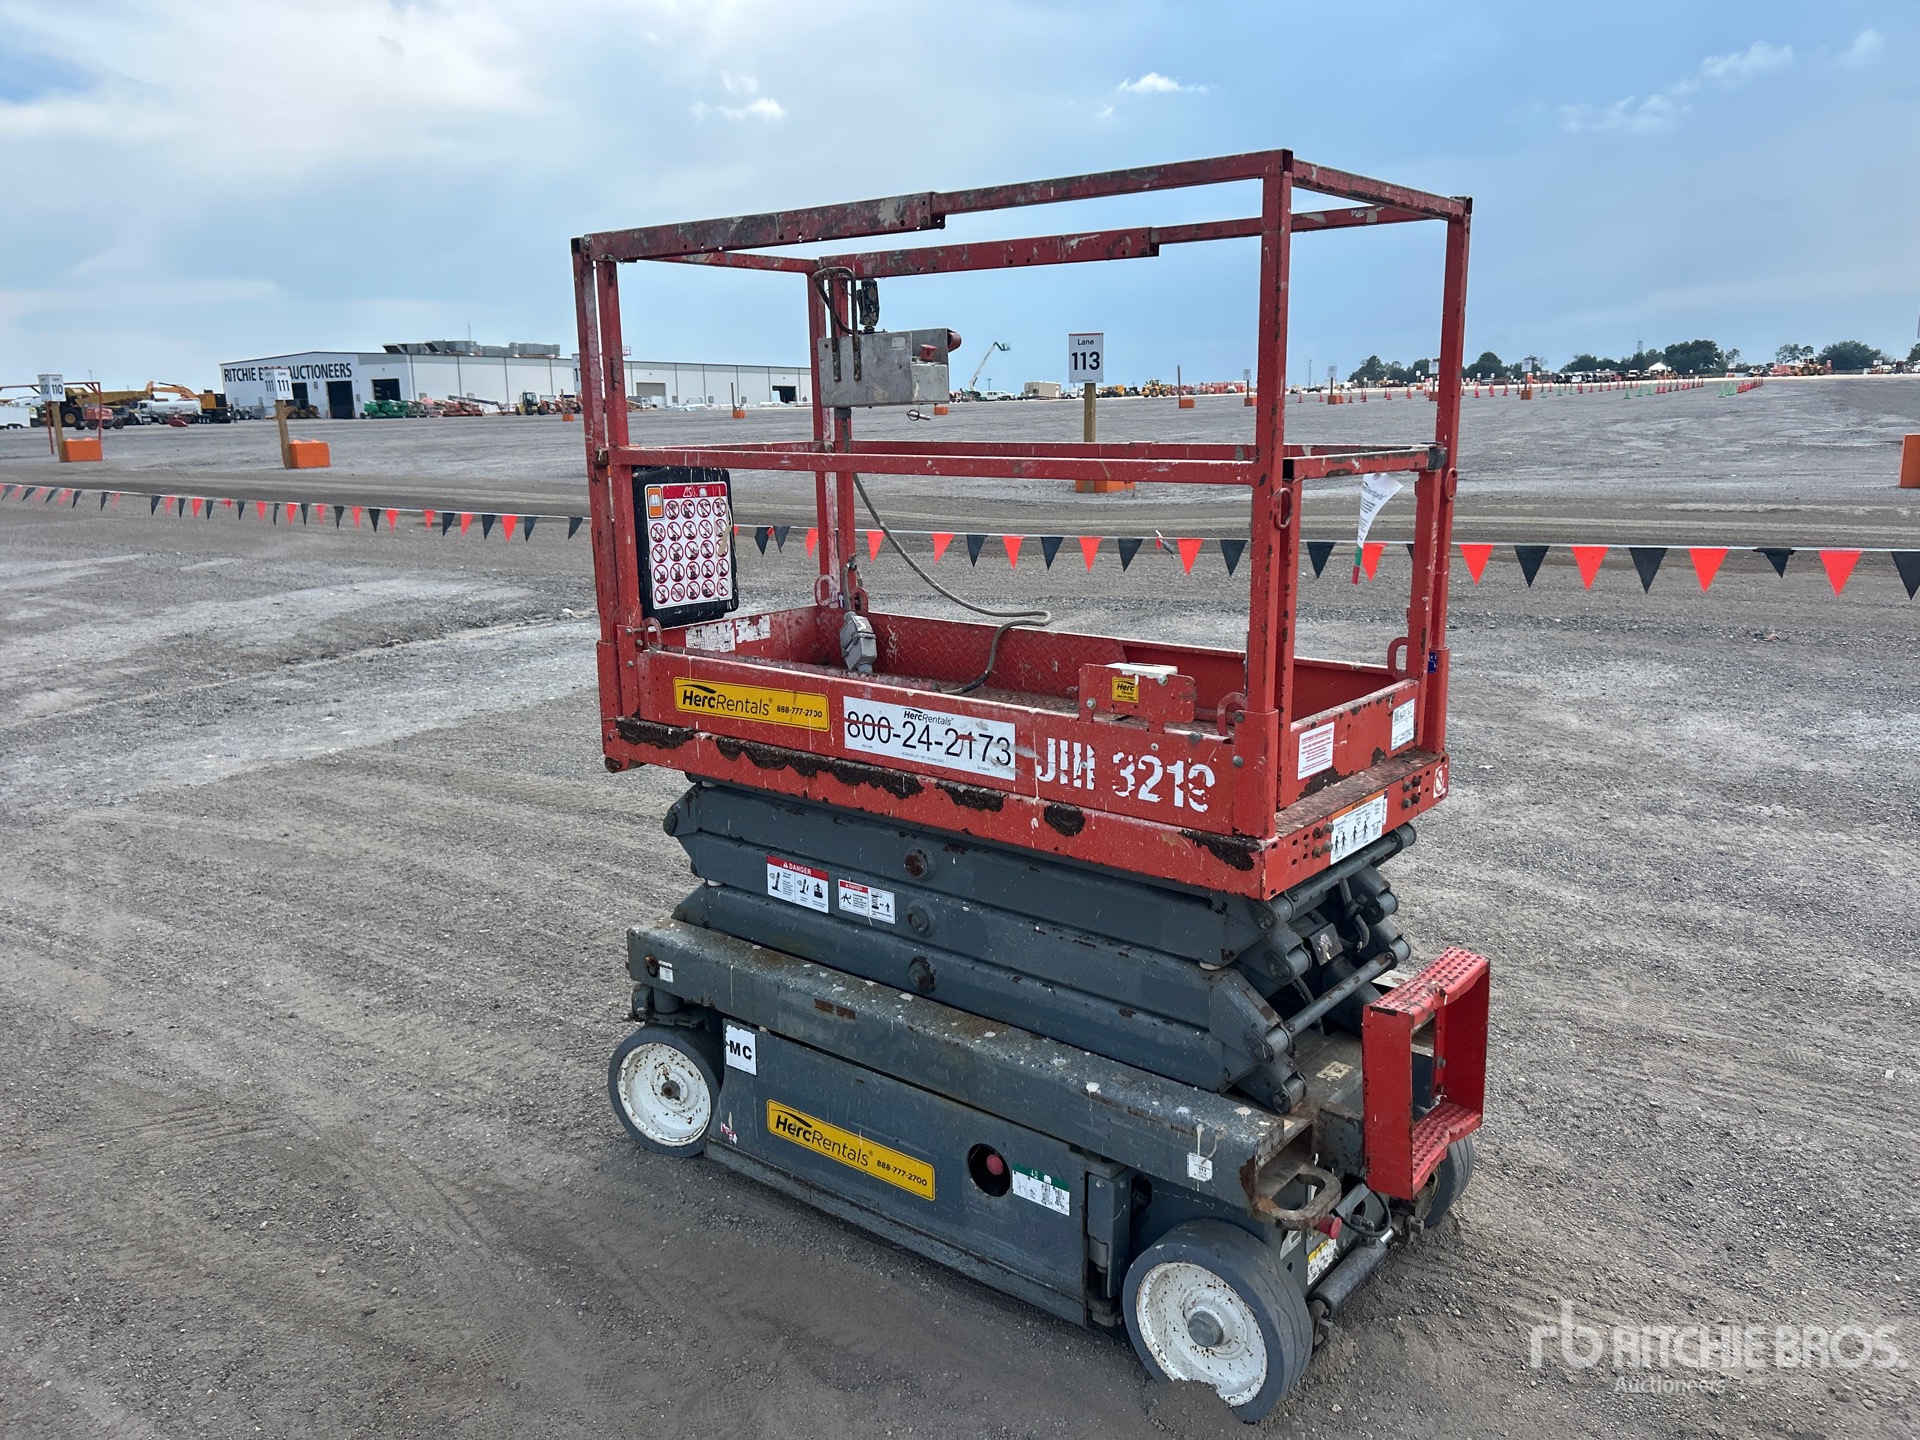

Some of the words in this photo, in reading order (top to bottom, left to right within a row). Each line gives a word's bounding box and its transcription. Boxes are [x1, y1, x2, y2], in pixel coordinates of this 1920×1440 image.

[1077, 338, 1094, 346] Lane
[1071, 351, 1100, 371] 113
[224, 367, 257, 382] RITCHIE
[51, 384, 63, 394] 110
[277, 380, 290, 391] 111
[1116, 682, 1135, 692] Herc
[682, 689, 770, 716] HercRentals
[776, 705, 823, 718] 888-777-2700
[903, 710, 952, 726] HercRentals
[847, 710, 1012, 767] 800-24-2173
[788, 861, 812, 875] DANGER
[729, 1039, 753, 1061] MC
[775, 1114, 870, 1167] HercRentals
[876, 1159, 928, 1187] 888-777-2700
